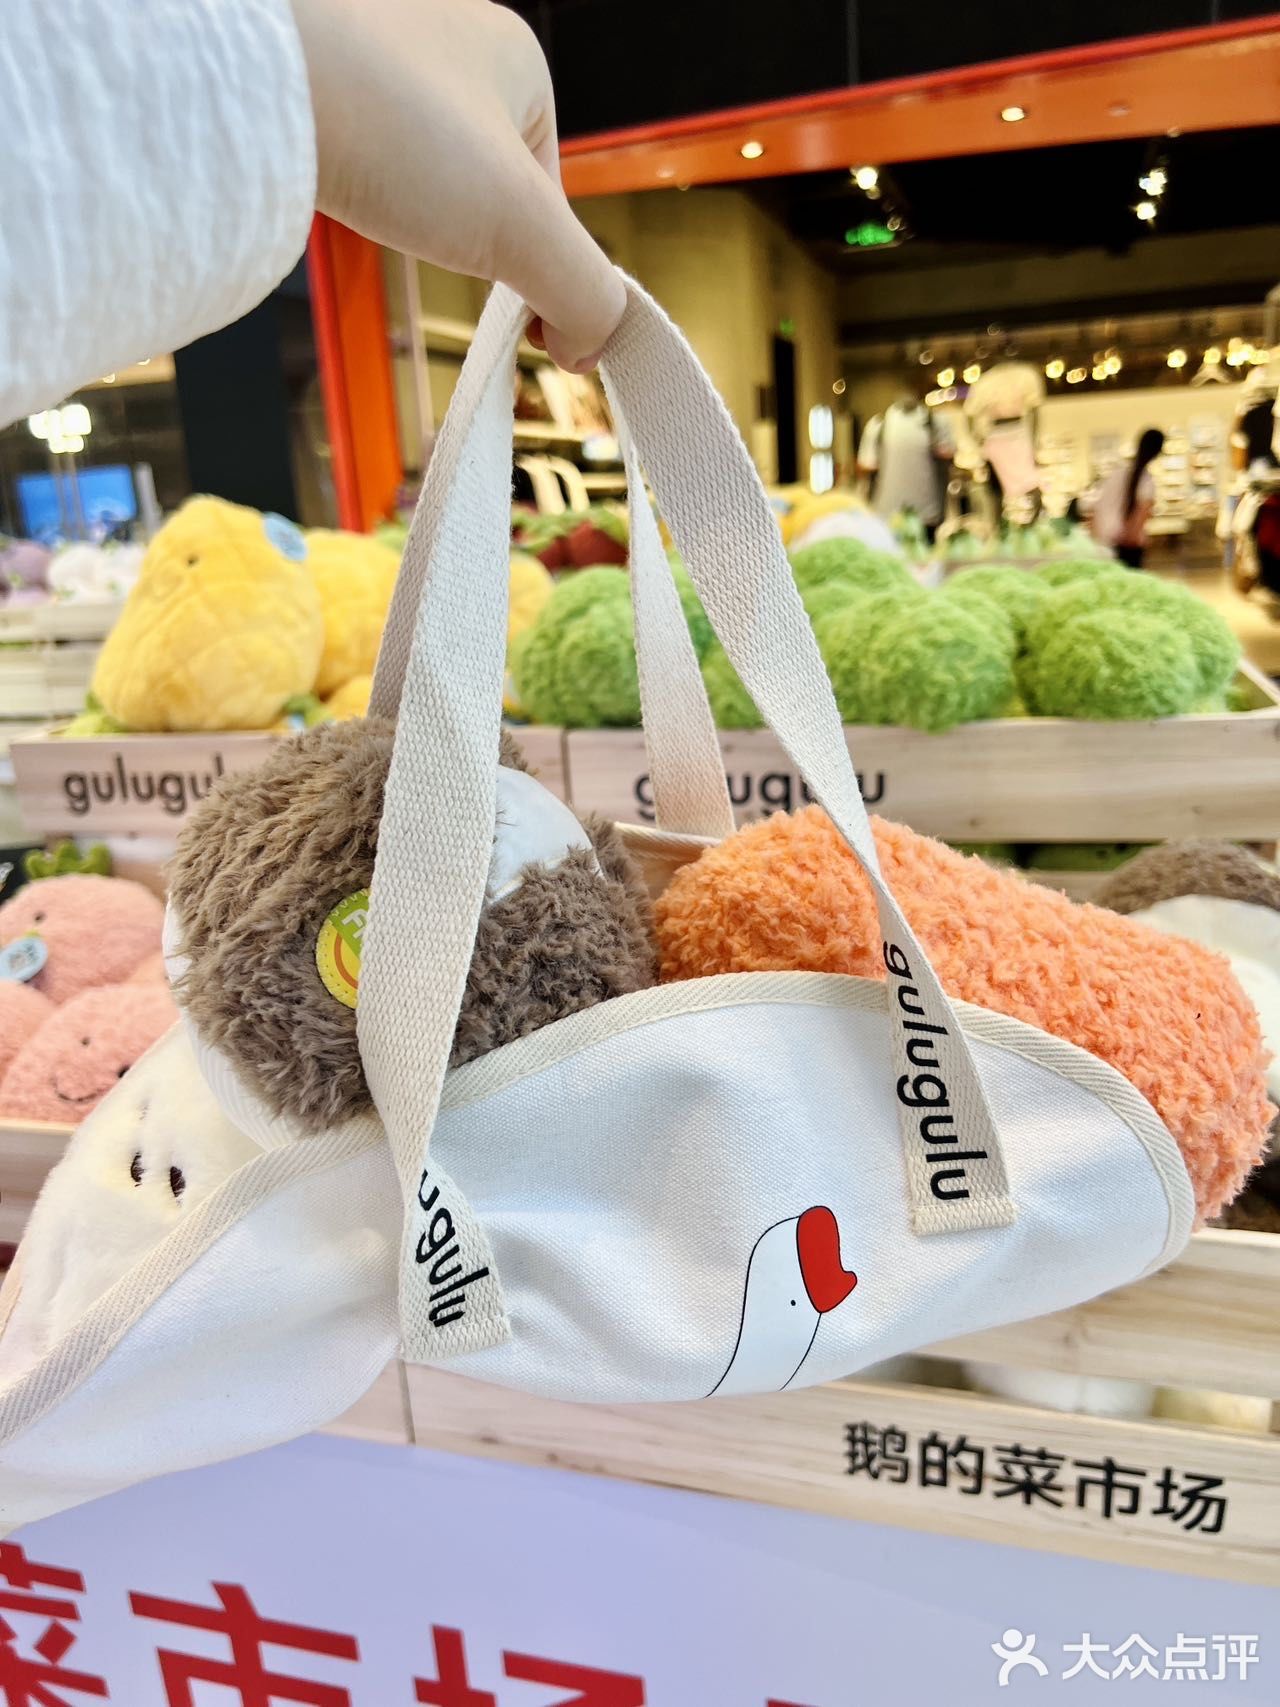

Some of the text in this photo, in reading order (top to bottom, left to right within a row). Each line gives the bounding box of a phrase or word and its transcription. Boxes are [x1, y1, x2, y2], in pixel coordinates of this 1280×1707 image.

[883, 940, 988, 1201] gulugulu
[844, 1420, 1229, 1534] 鹅的菜市场
